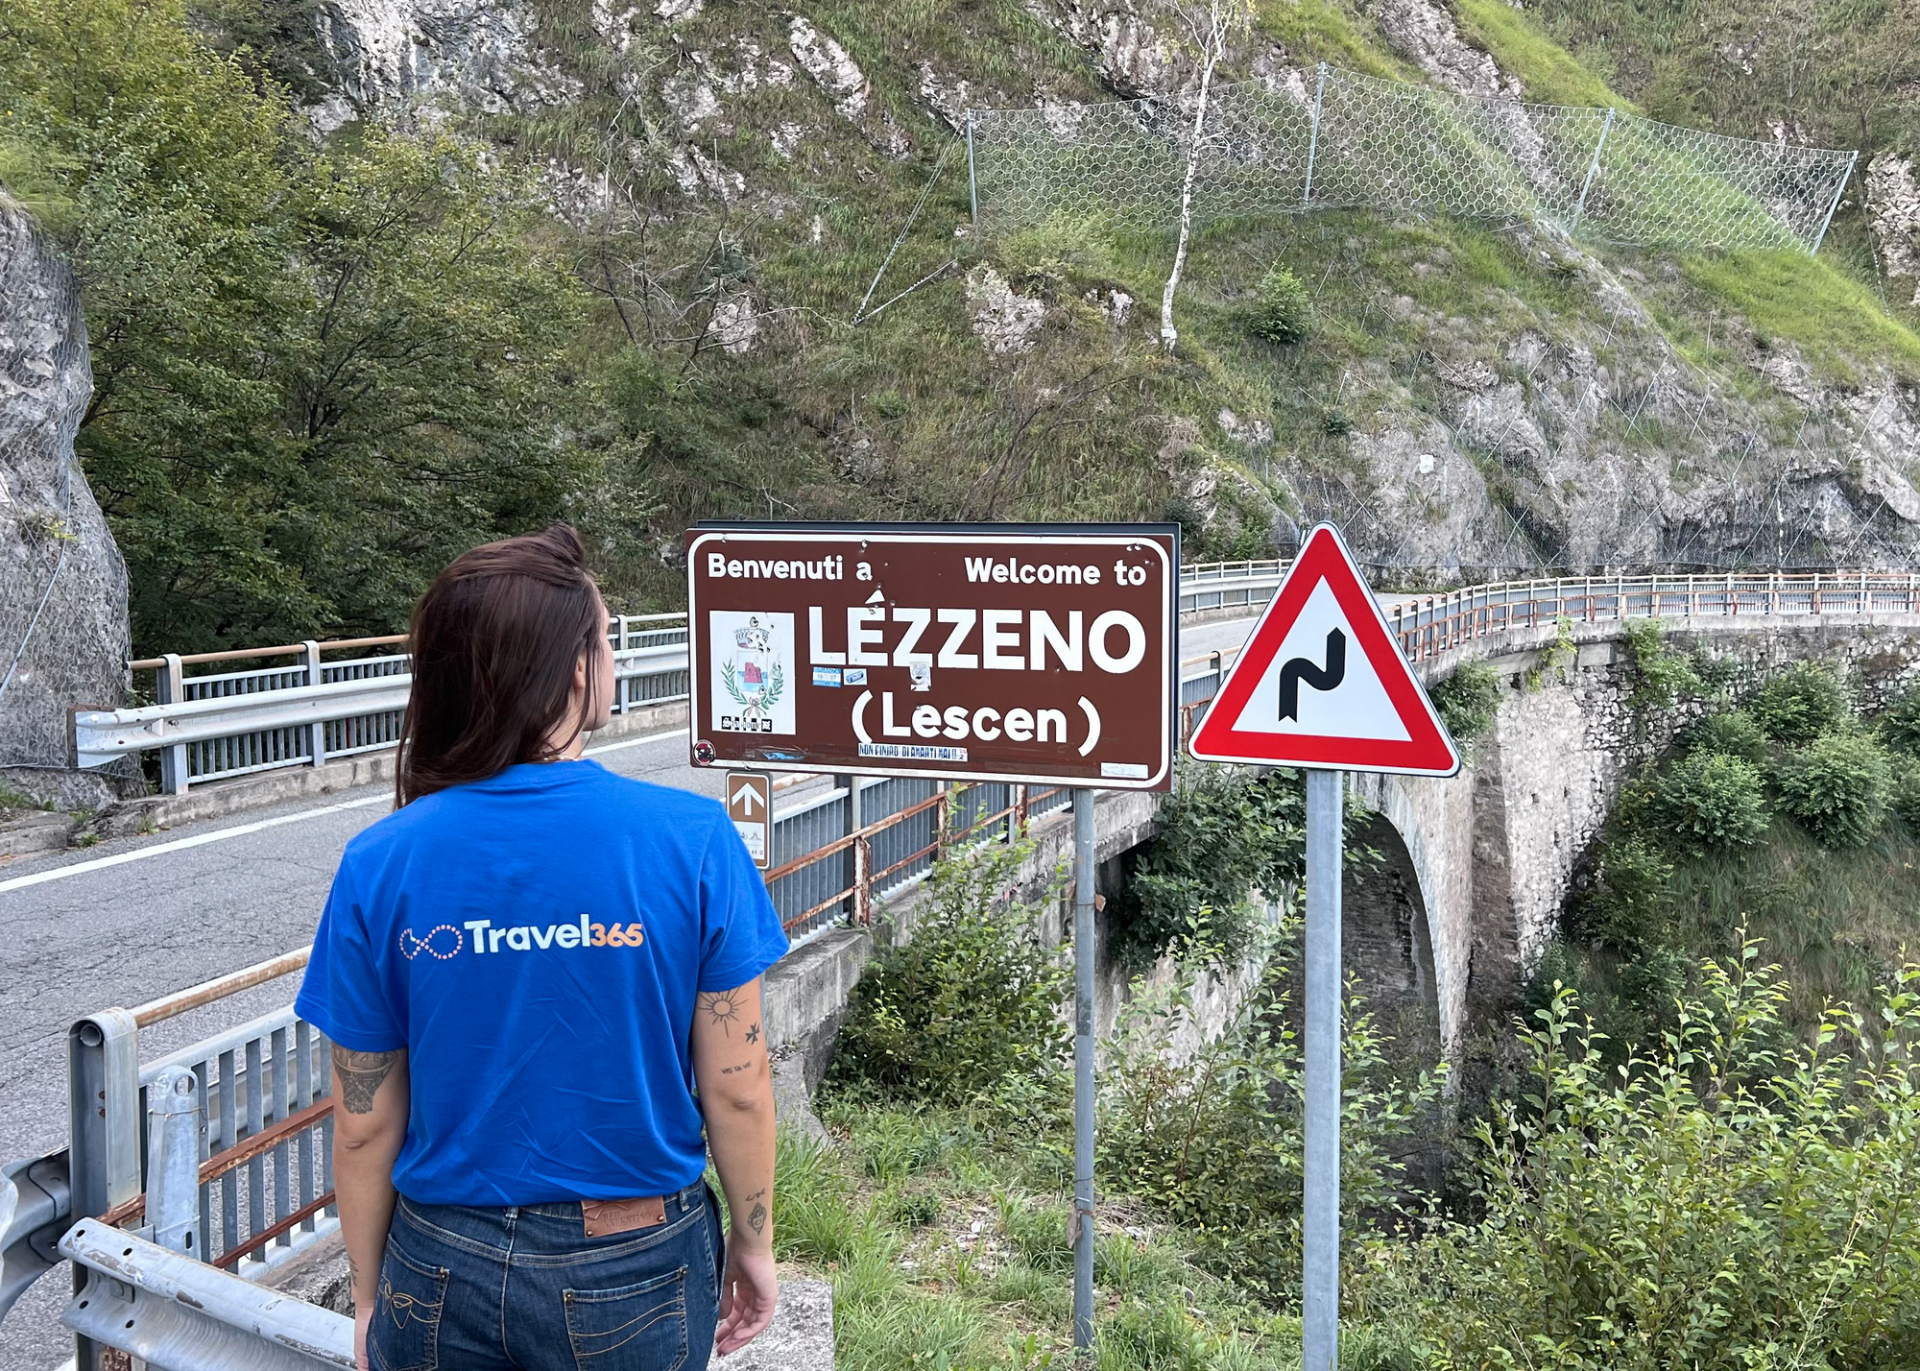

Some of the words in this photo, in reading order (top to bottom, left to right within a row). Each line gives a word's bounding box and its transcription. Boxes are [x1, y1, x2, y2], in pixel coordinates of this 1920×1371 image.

[709, 553, 843, 580] Benvenuti
[856, 561, 873, 581] a
[965, 557, 1101, 585] Welcome
[1114, 560, 1147, 586] to
[808, 589, 1146, 674] LÉZZENO
[859, 744, 873, 756] NON
[902, 746, 909, 757] DI
[911, 746, 937, 759] AMARTI
[464, 913, 644, 954] Travel365
